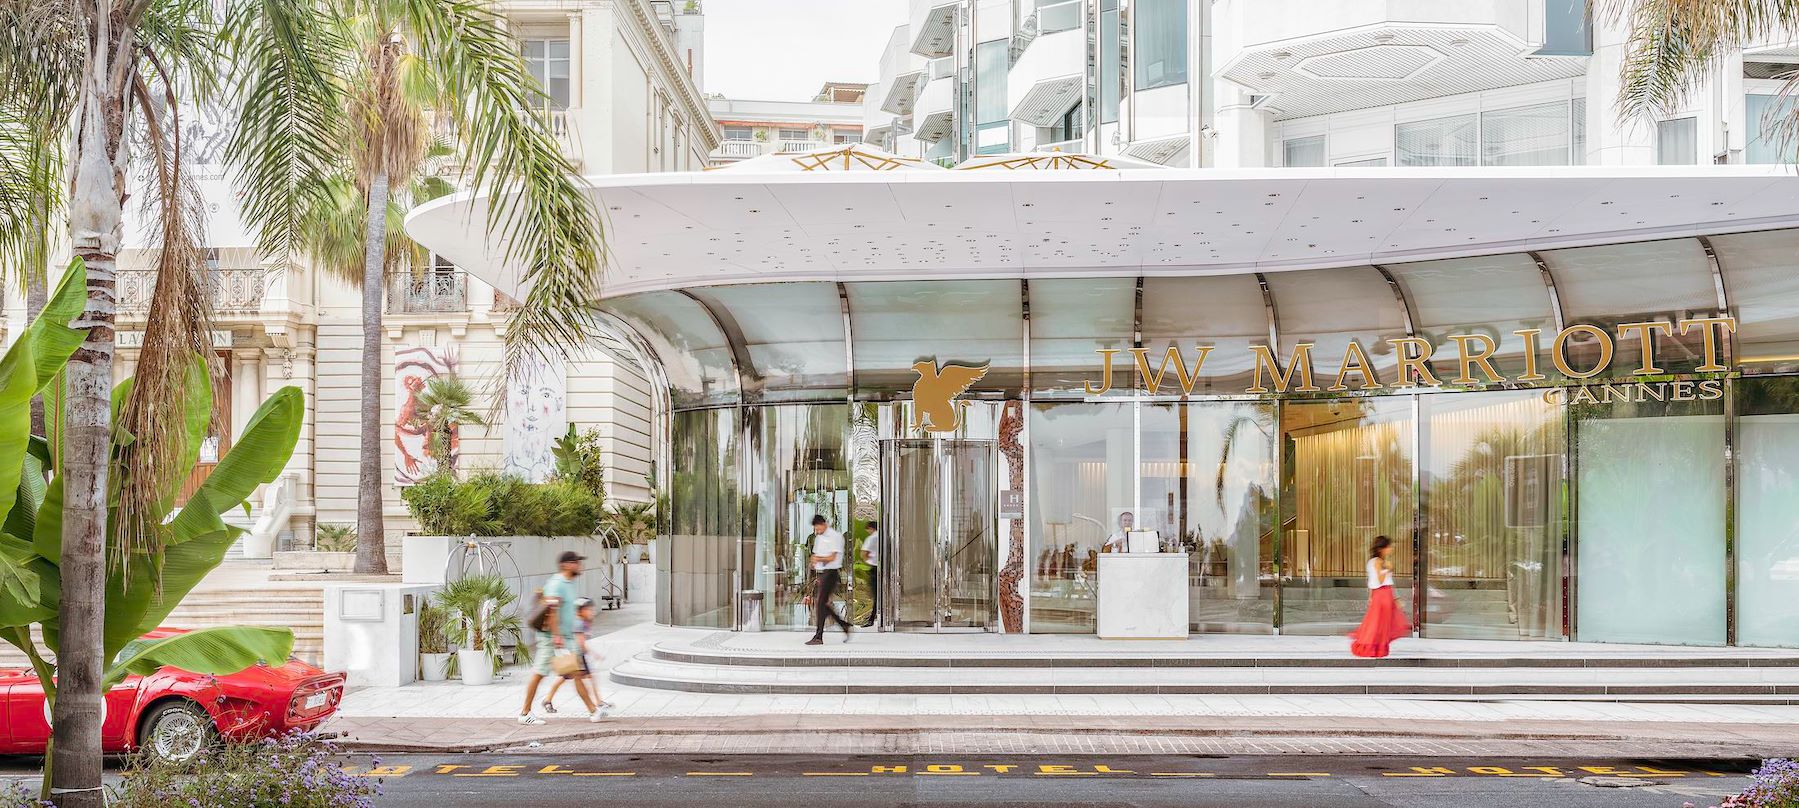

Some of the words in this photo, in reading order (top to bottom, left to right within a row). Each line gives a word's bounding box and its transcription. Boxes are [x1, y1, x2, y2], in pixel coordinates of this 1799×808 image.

[1084, 346, 1214, 396] JW
[1246, 317, 1736, 393] MARRIOTT
[1543, 380, 1724, 406] CANNES
[1010, 495, 1018, 503] H
[872, 764, 1137, 773] HOTEL
